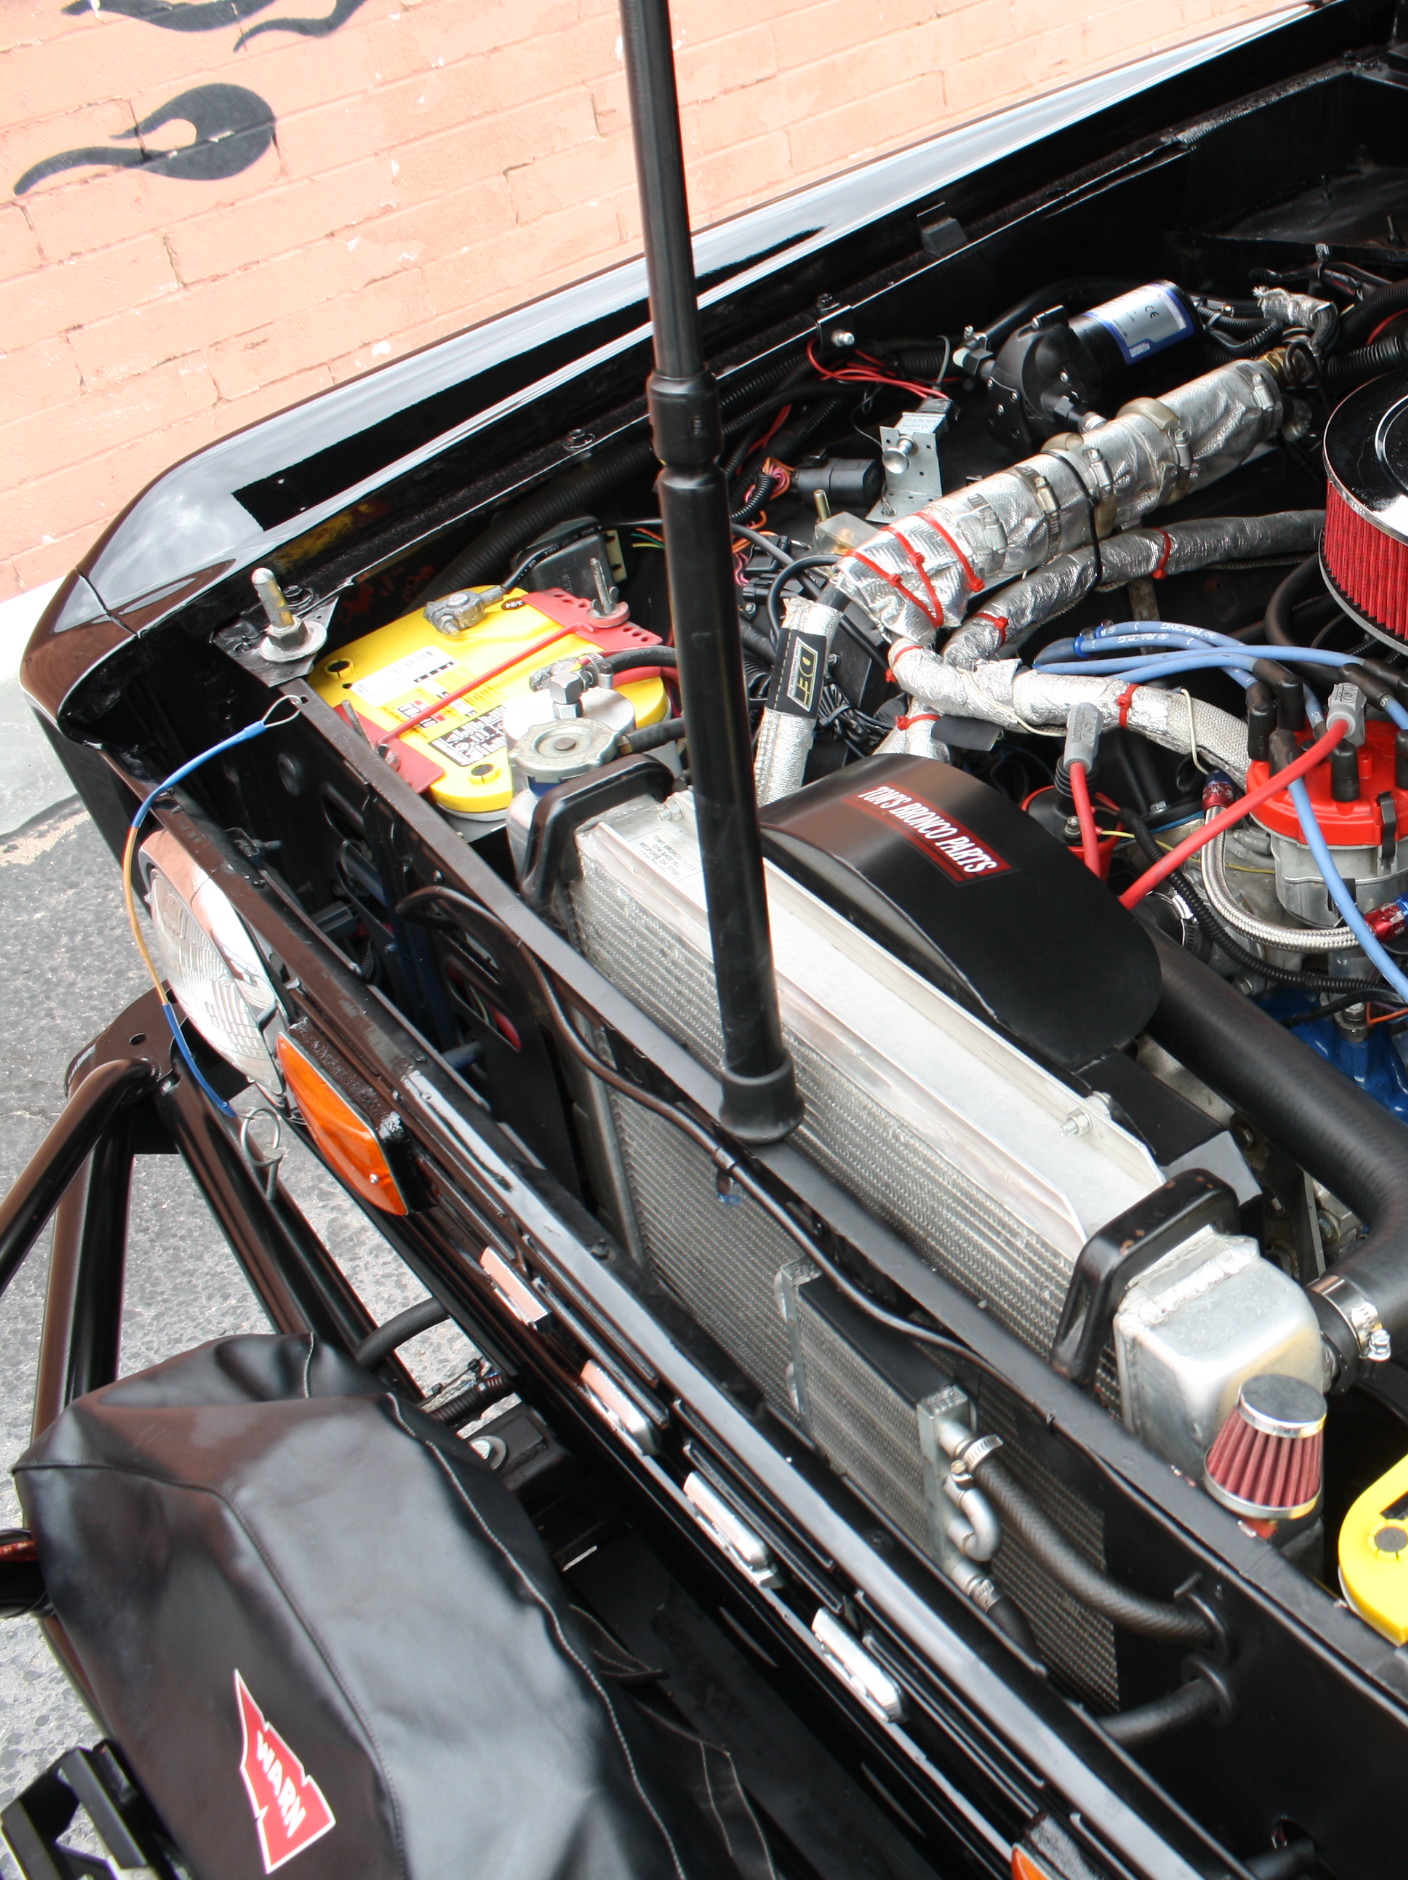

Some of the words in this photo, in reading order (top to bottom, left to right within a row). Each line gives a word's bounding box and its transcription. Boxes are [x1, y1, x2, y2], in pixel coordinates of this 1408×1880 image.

[858, 786, 909, 810] TOM'S
[889, 801, 959, 841] BRONCO
[935, 835, 998, 874] PARTS
[256, 1729, 307, 1839] WARN
